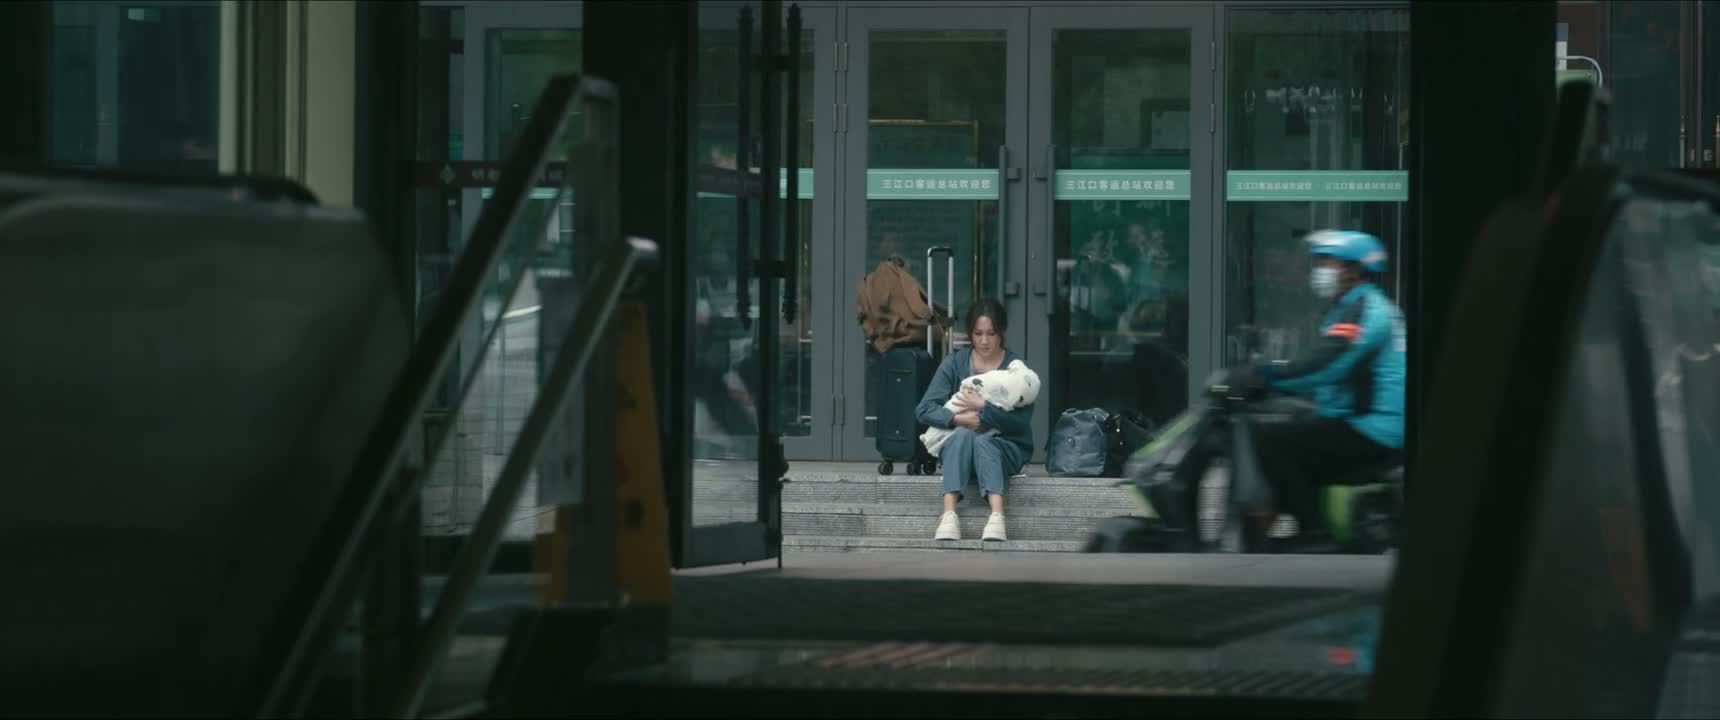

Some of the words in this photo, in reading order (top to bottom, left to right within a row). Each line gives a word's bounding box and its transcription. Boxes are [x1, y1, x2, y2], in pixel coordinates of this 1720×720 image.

[1064, 179, 1175, 190] 三江口客运总站欢迎您
